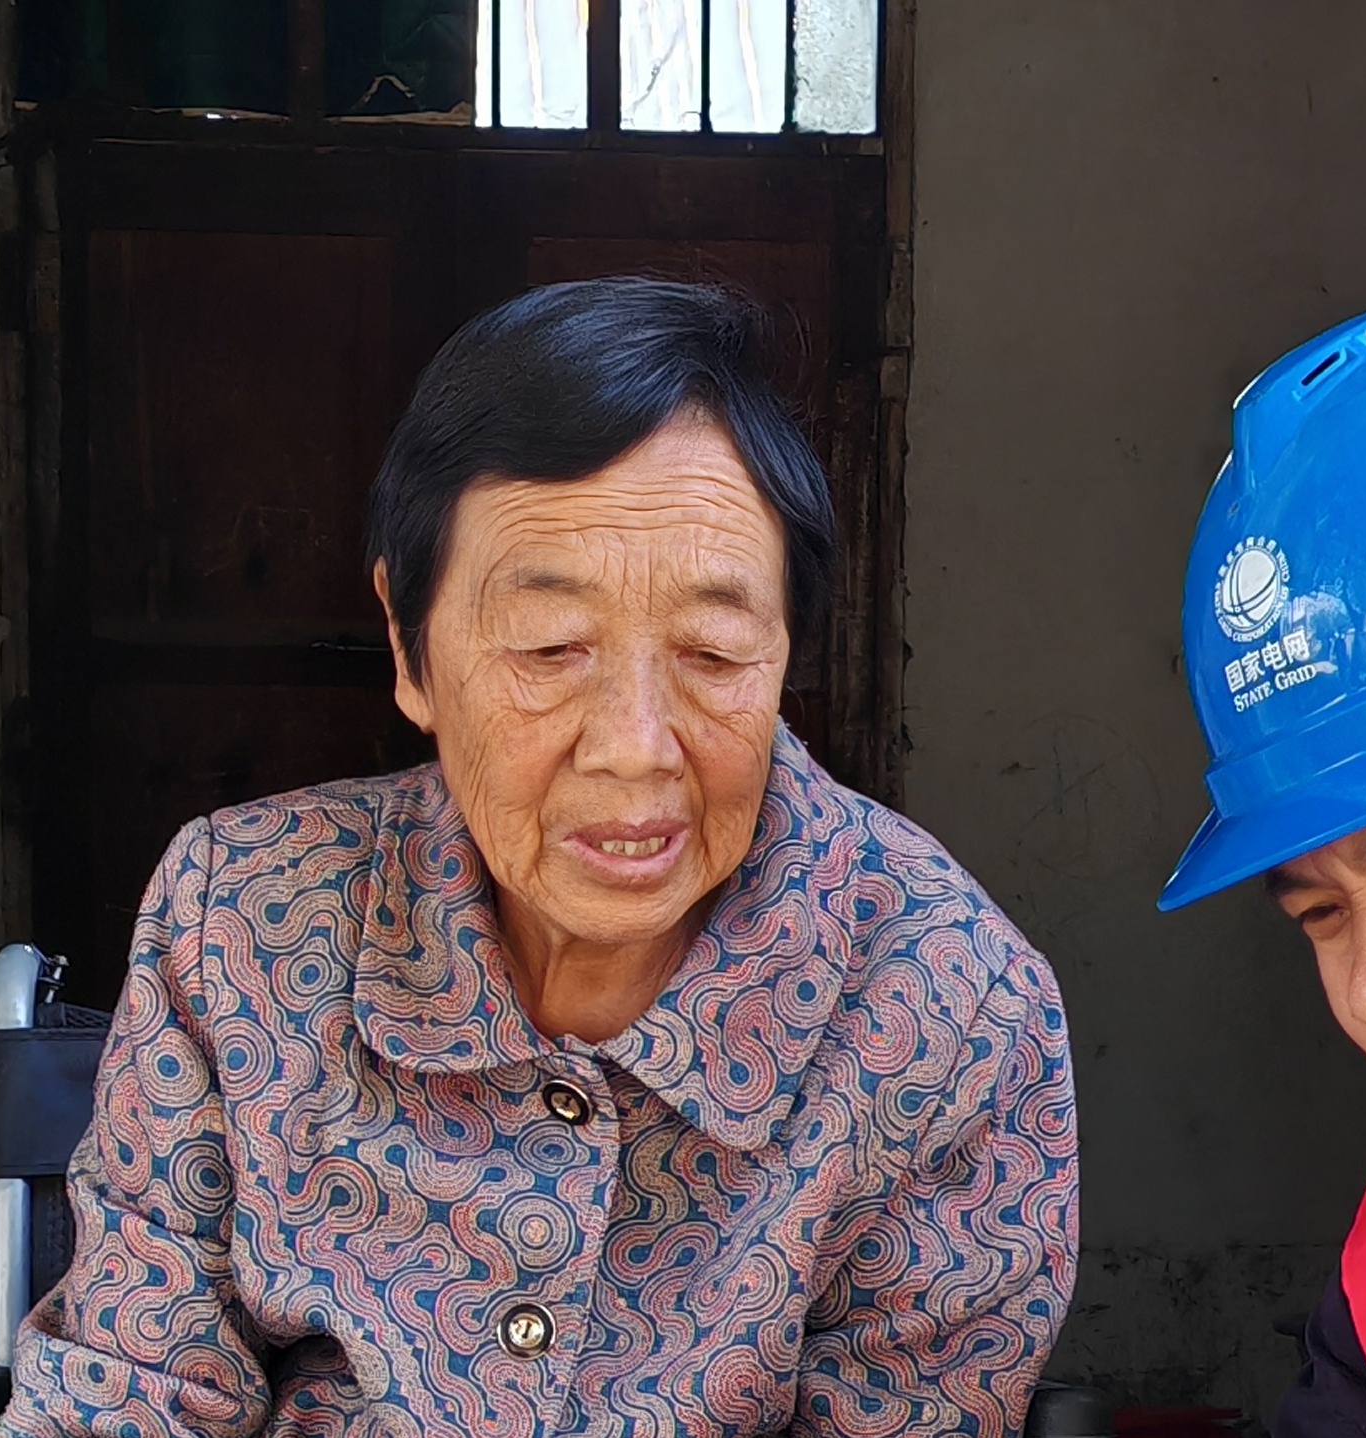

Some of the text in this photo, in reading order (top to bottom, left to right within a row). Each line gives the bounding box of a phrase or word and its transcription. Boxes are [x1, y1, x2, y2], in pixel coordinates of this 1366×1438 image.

[1225, 629, 1311, 693] 国家电网
[1233, 663, 1318, 713] STATE GRID
